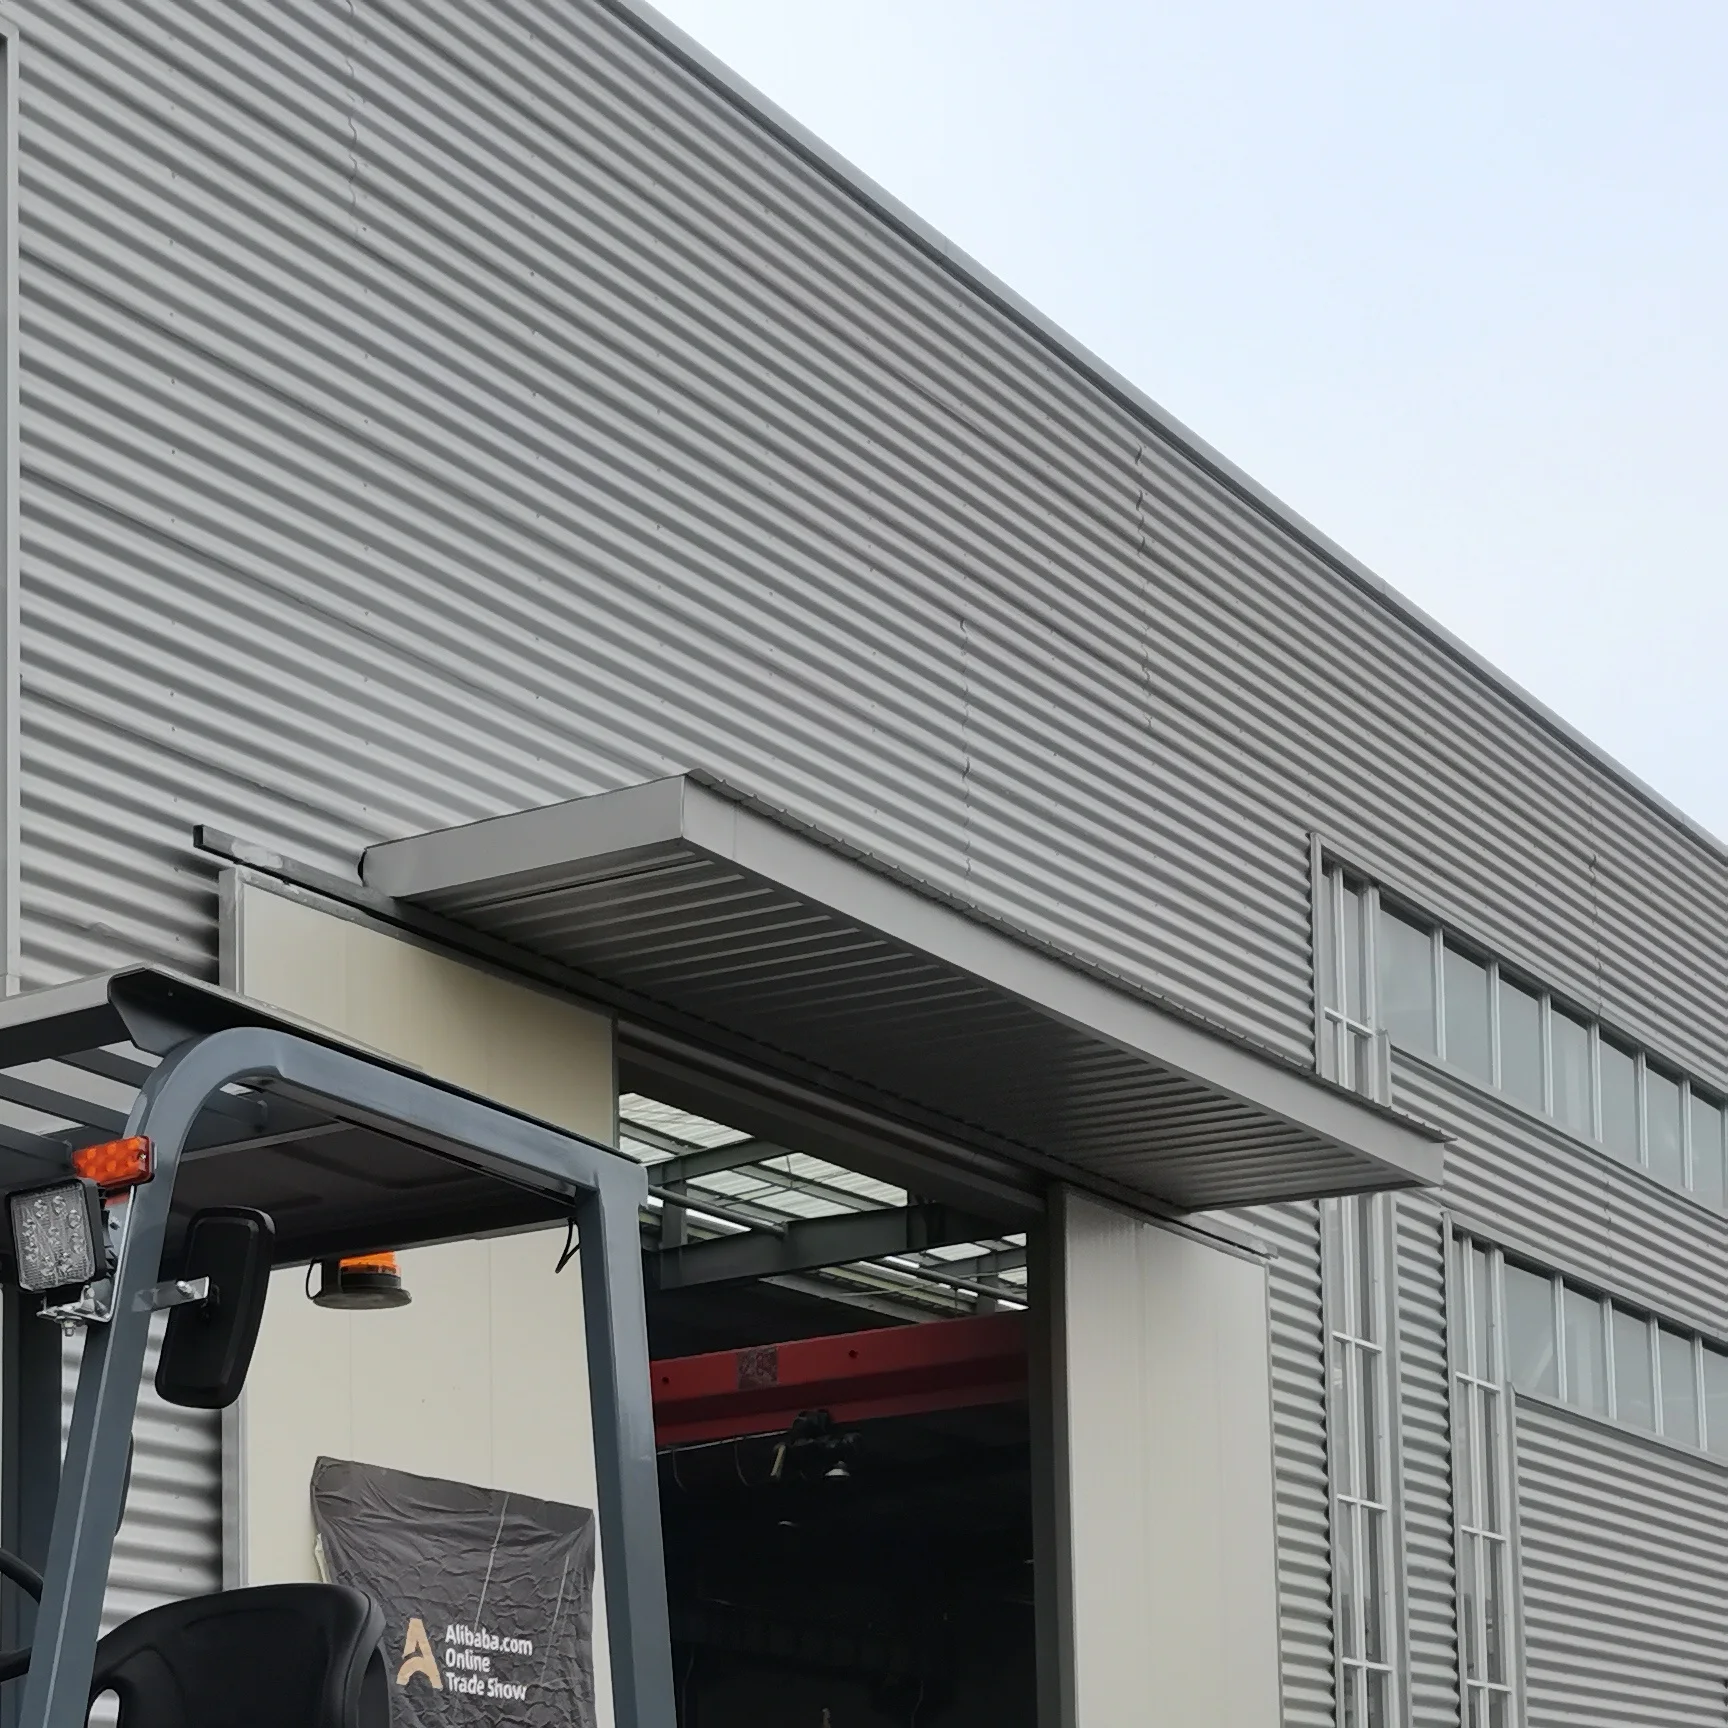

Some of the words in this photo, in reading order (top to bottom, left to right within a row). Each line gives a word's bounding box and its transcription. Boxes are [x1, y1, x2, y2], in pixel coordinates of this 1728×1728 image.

[445, 1624, 533, 1656] Alibaba.com
[445, 1647, 491, 1673] Online
[446, 1672, 485, 1696] Trade
[486, 1678, 529, 1701] Show
